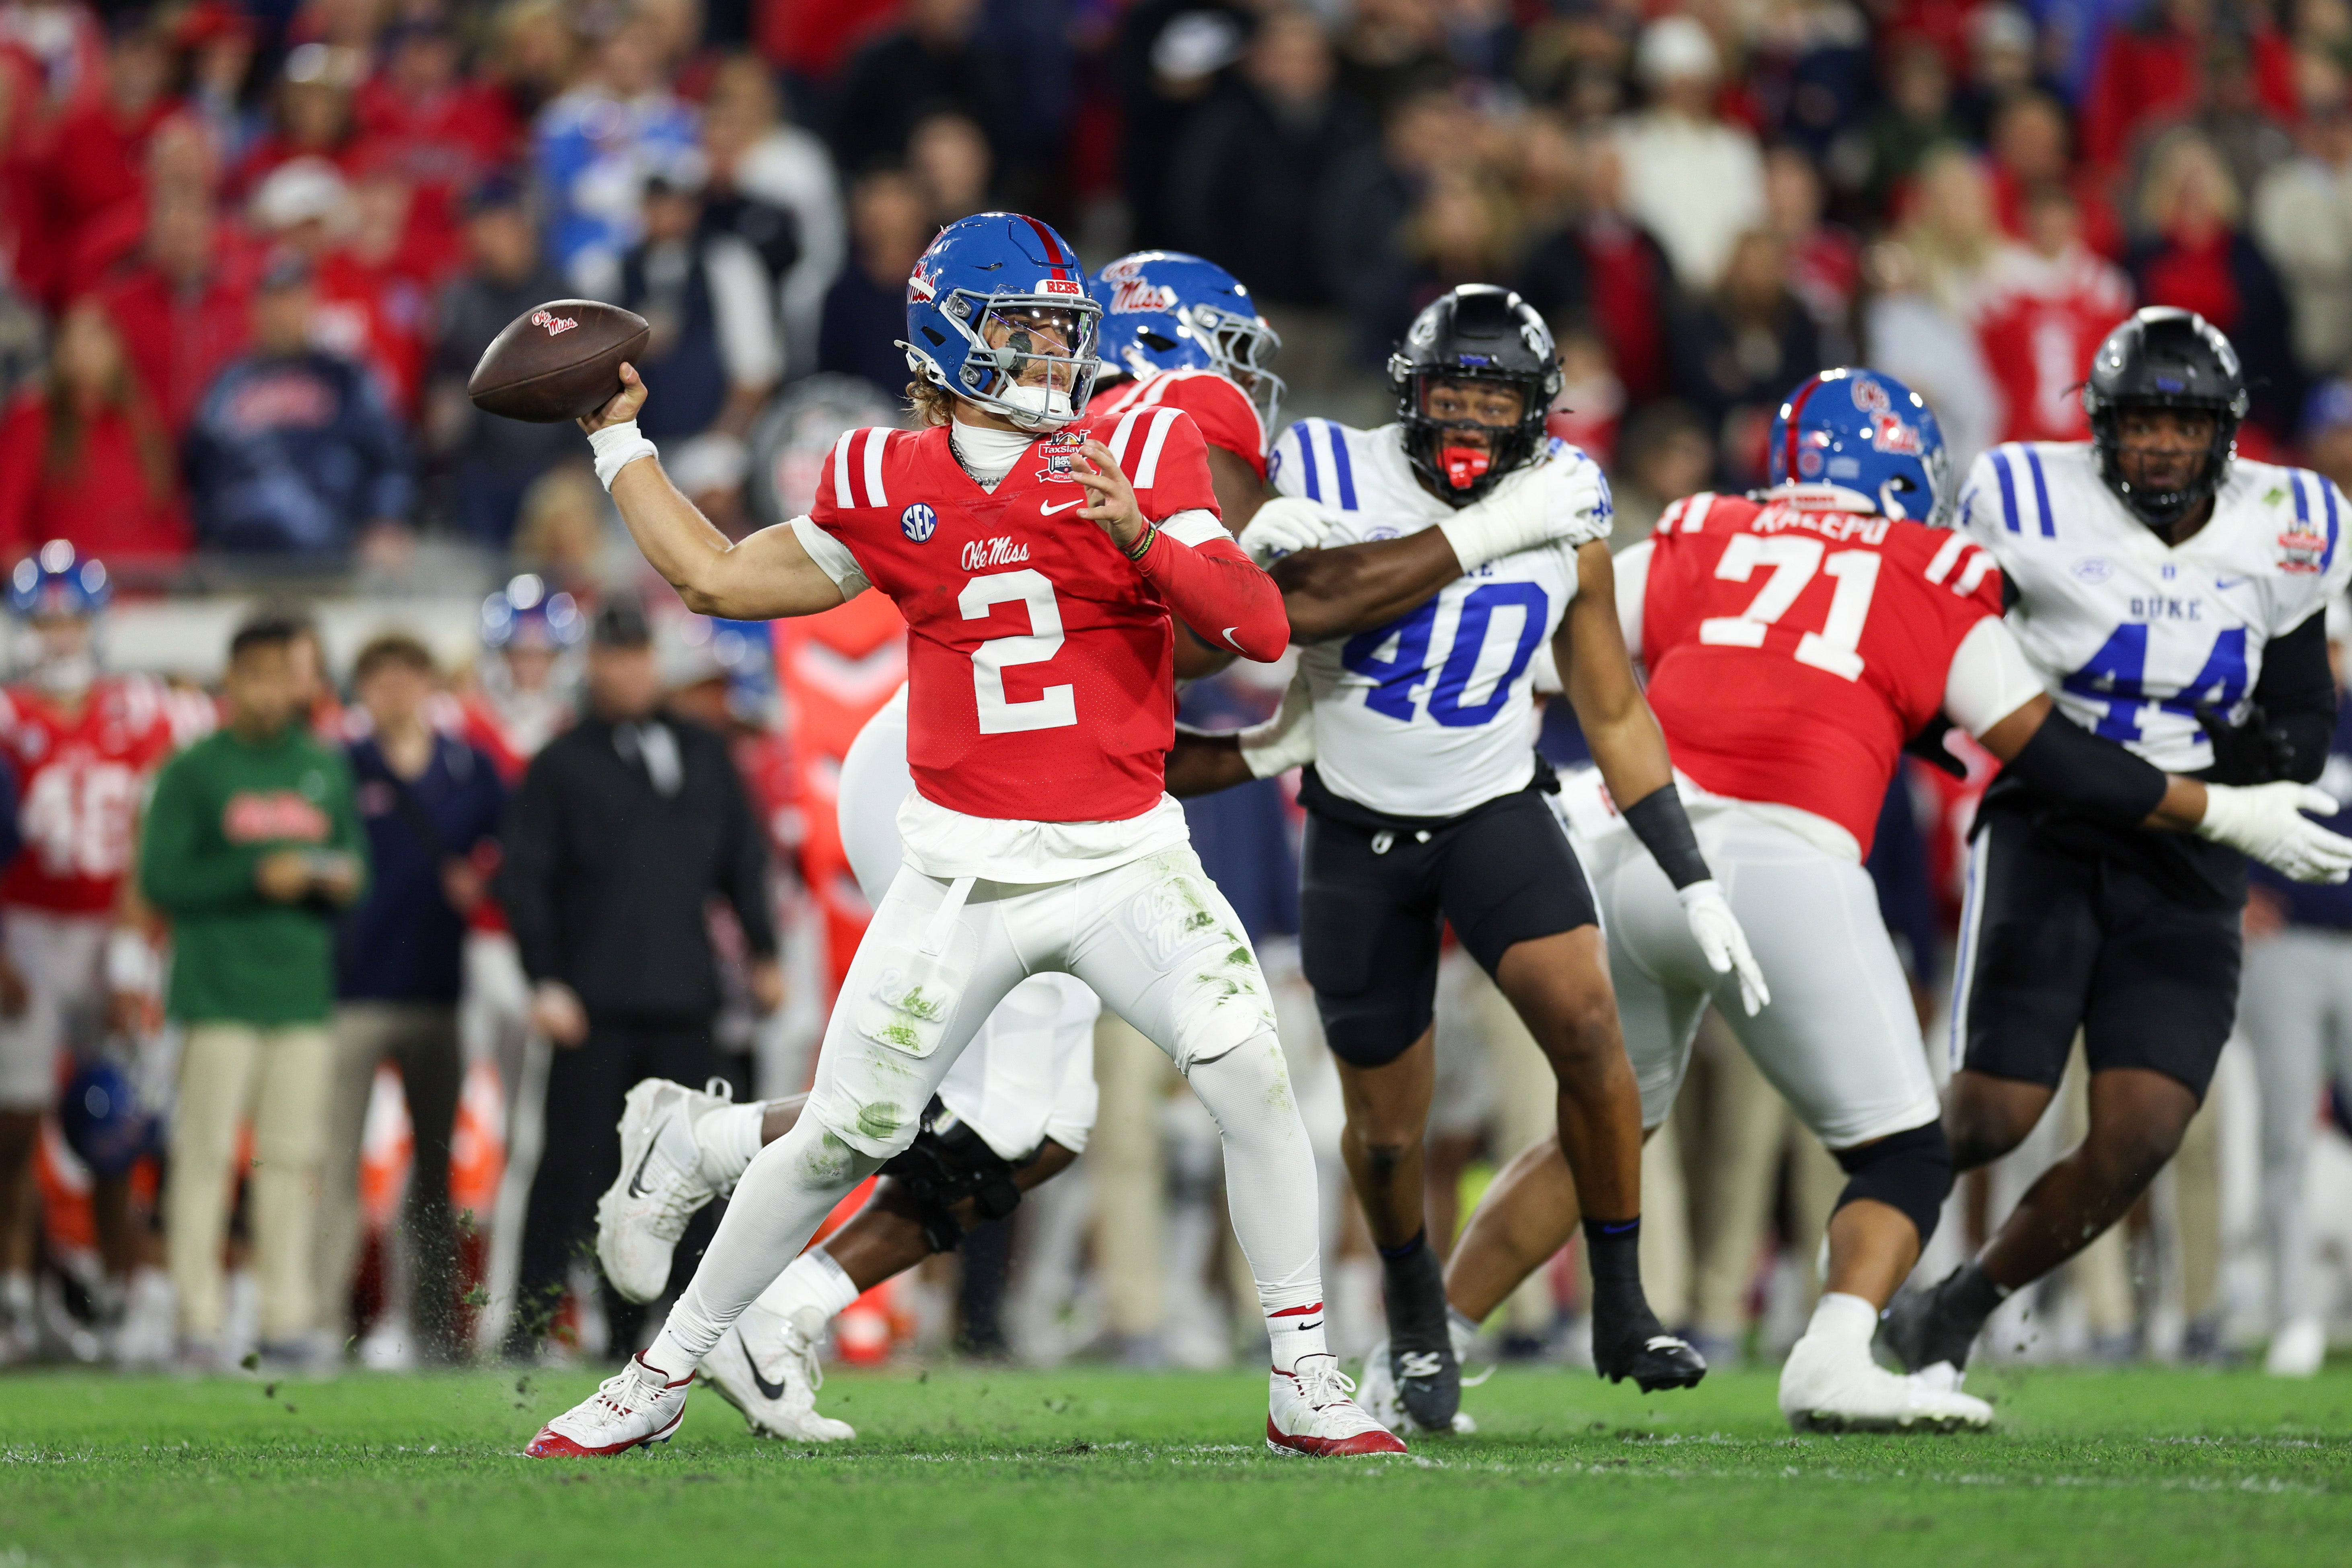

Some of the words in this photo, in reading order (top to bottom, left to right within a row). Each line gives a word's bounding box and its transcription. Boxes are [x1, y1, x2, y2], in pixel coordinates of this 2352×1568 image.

[1046, 281, 1079, 294] REBS
[531, 310, 551, 326] Ole
[543, 317, 578, 336] Miss
[1042, 445, 1082, 454] TaxSlay
[901, 504, 935, 541] SEC
[961, 540, 987, 571] Ole
[987, 536, 1030, 566] Miss
[1699, 532, 1882, 683] 71
[2130, 596, 2202, 622] DUKE
[957, 568, 1078, 735] 2
[1342, 582, 1548, 728] 40
[2062, 623, 2247, 744] 44
